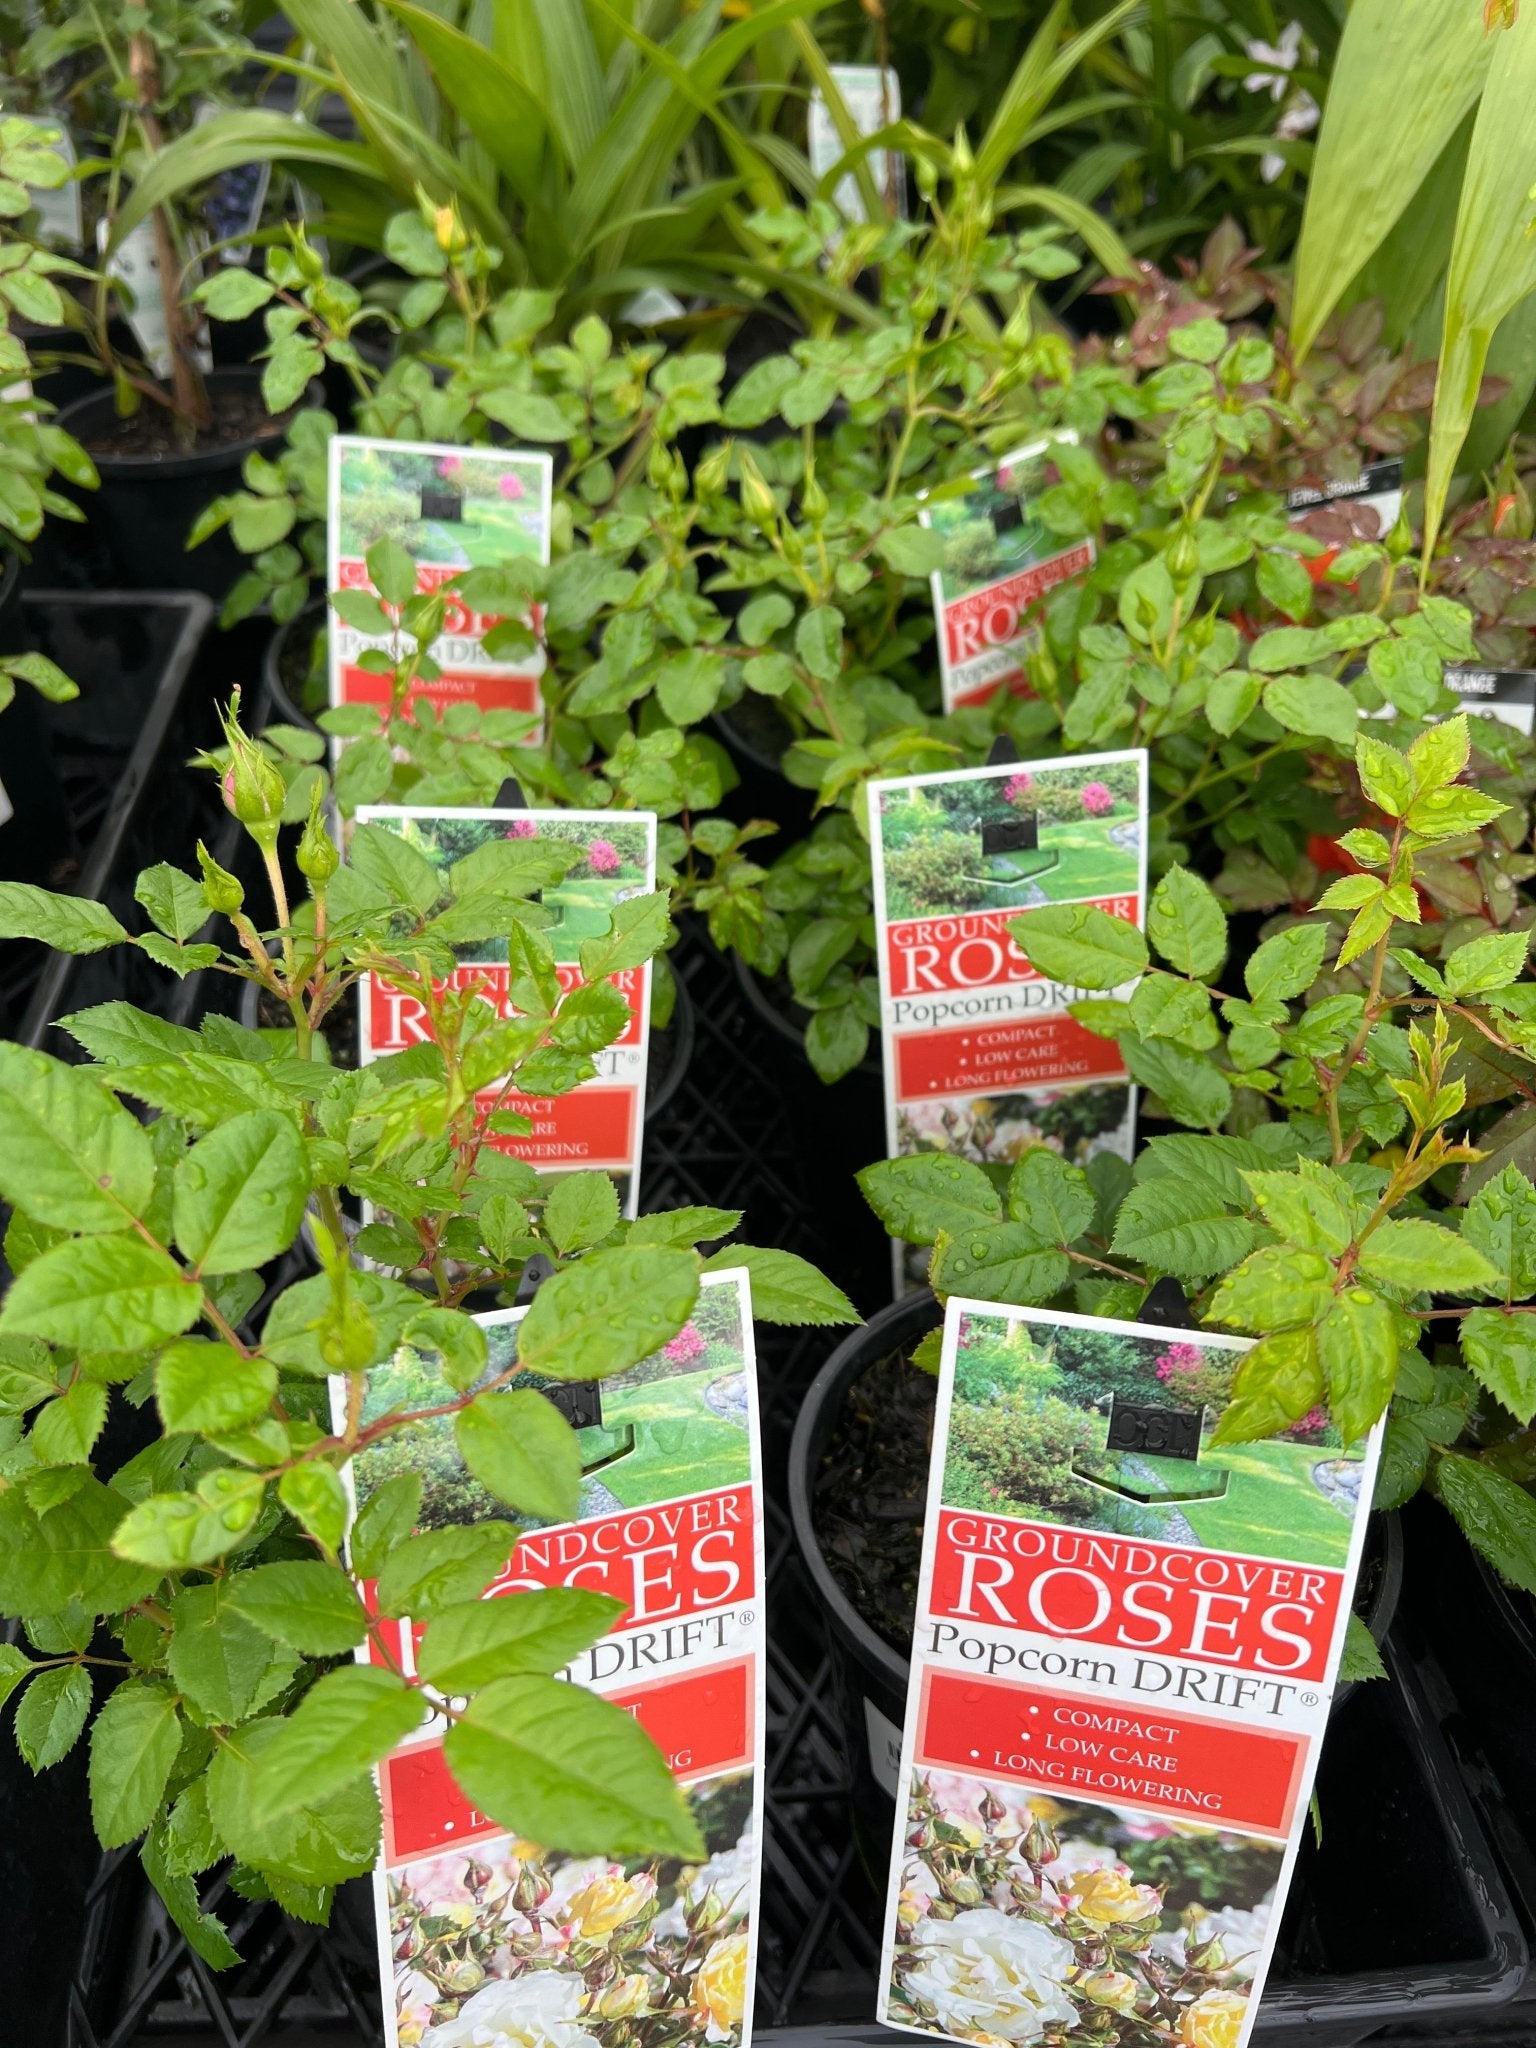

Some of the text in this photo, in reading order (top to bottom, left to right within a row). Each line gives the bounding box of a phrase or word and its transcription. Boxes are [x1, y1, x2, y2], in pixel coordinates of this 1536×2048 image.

[893, 993, 1013, 1026] Popcorn
[977, 1025, 1057, 1046] COMPACT
[975, 1044, 1058, 1065] LOW CARE
[945, 1060, 1089, 1088] LONG FLOWERING
[946, 1517, 1326, 1605] GROUNDCOVER
[948, 1549, 1315, 1671] ROSES
[927, 1622, 1117, 1686] Popcorn
[1053, 1707, 1179, 1743] COMPACT
[1046, 1733, 1177, 1772] LOW CARE
[994, 1751, 1223, 1810] LONG FLOWERING
